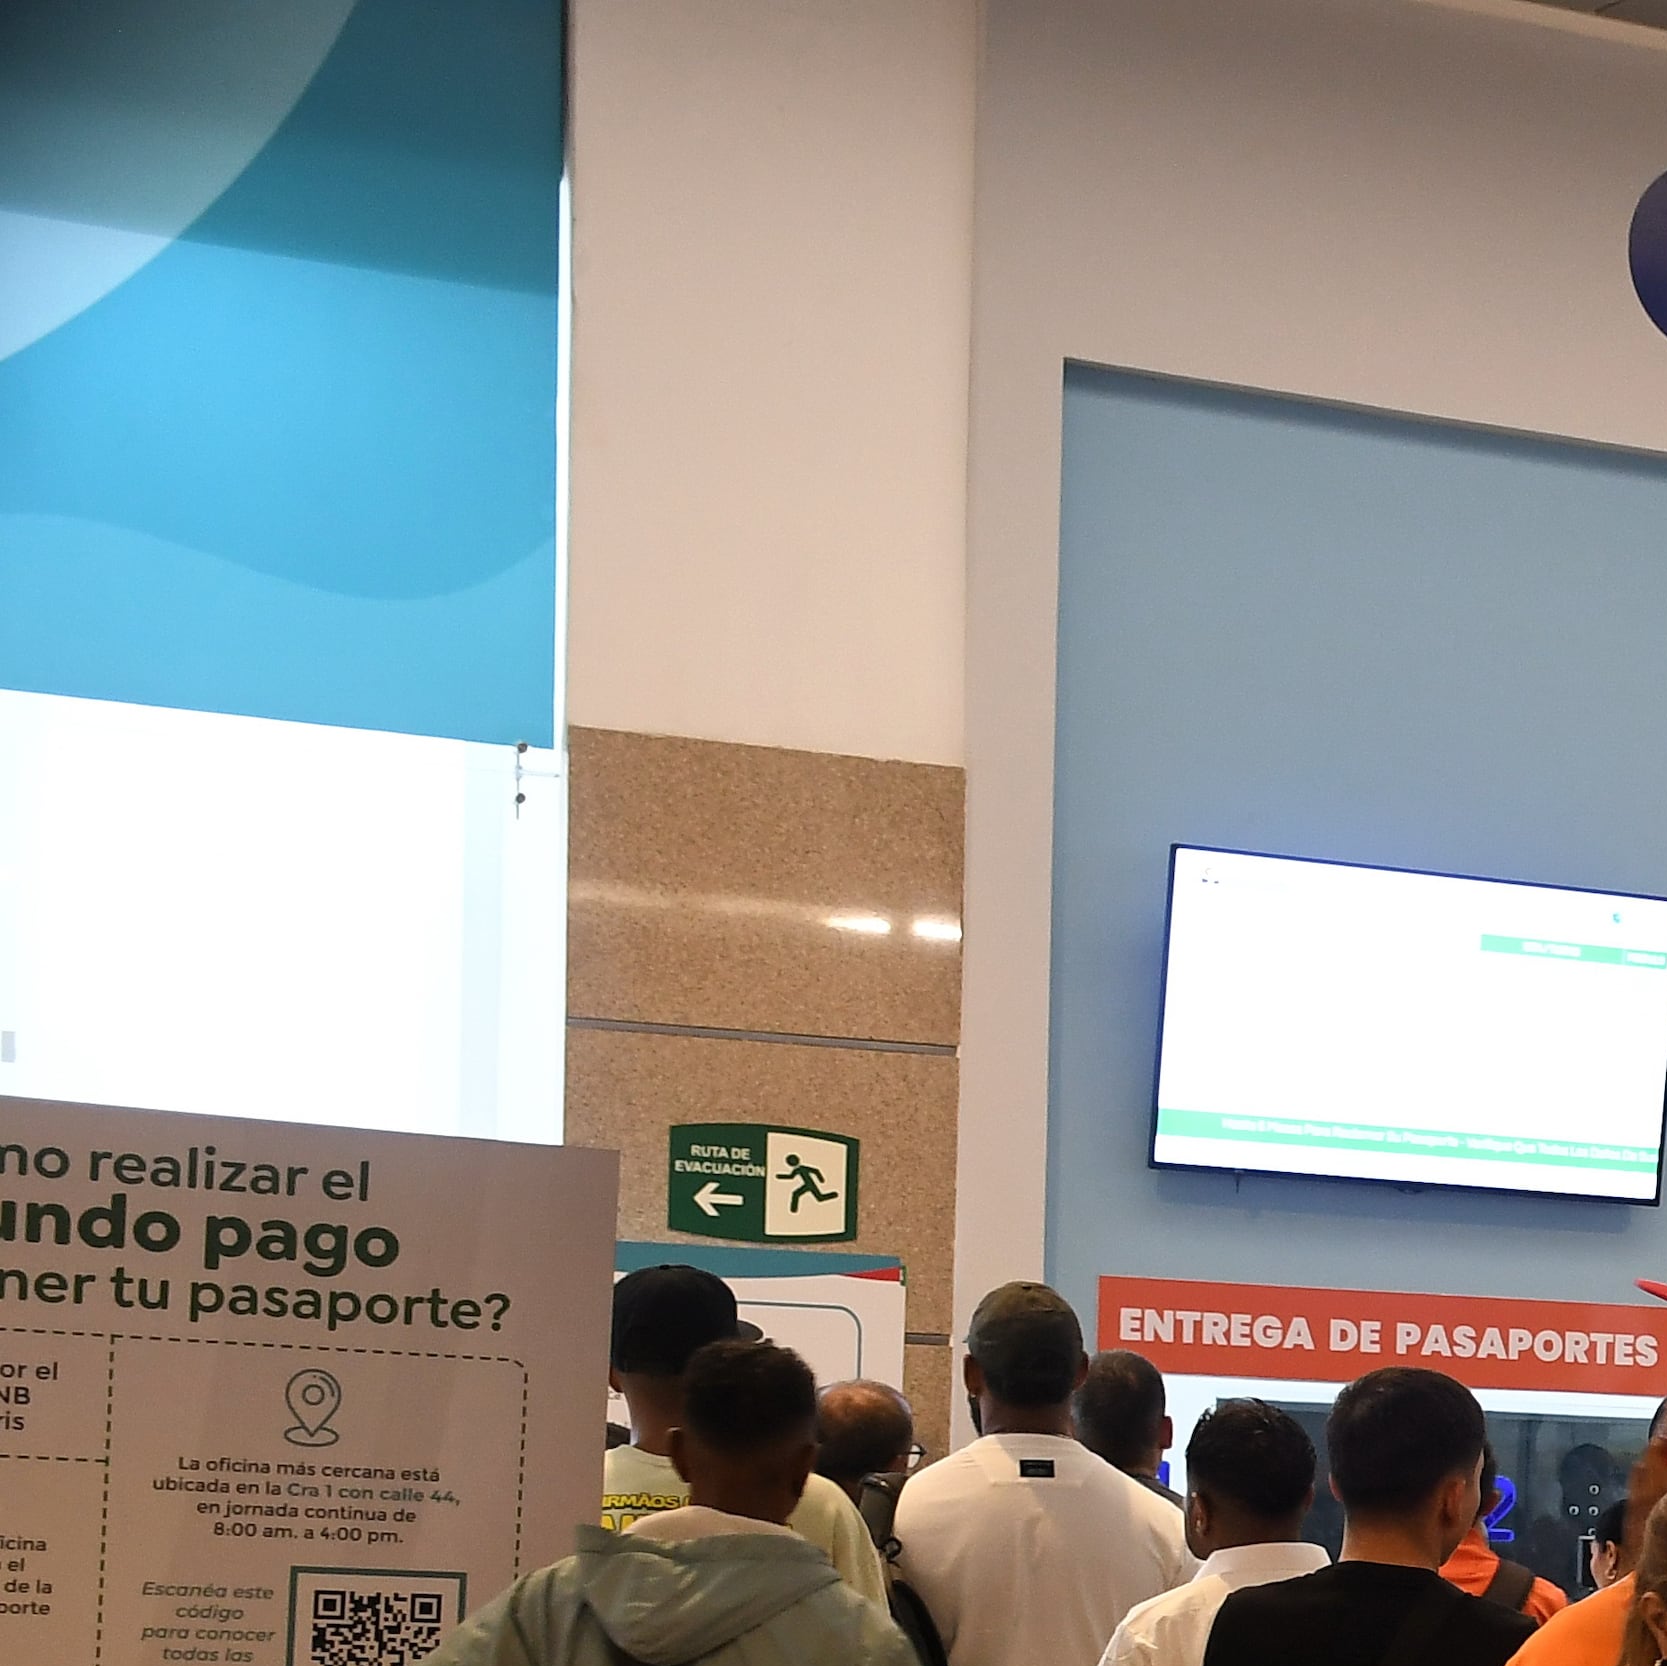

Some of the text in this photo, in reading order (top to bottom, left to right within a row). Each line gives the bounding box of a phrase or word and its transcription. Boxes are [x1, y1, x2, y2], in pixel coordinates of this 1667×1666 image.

[691, 1144, 750, 1161] RUTA DE
[89, 1147, 309, 1197] realizar
[321, 1161, 371, 1202] el
[674, 1159, 765, 1178] EVACUACIÓN
[204, 1212, 400, 1277] pago
[110, 1267, 169, 1310] tu
[189, 1279, 512, 1332] pasaporte?
[1118, 1307, 1659, 1367] ENTREGA DE PASAPORTES
[35, 1361, 58, 1381] el
[0, 1411, 25, 1431] is
[178, 1456, 441, 1482] La oficina más cercana está
[152, 1478, 461, 1506] ubicada en la Cra 1 con calle 44,
[196, 1500, 417, 1523] en jornada continua de
[1483, 1475, 1517, 1542] 2
[213, 1521, 404, 1545] 8:00 am. a 4:00 pm.
[7, 1557, 25, 1572] el
[4, 1579, 53, 1595] de la
[141, 1581, 274, 1600] Escanéa este
[175, 1603, 244, 1623] código
[140, 1626, 277, 1643] para conocer
[161, 1646, 254, 1663] todas las
